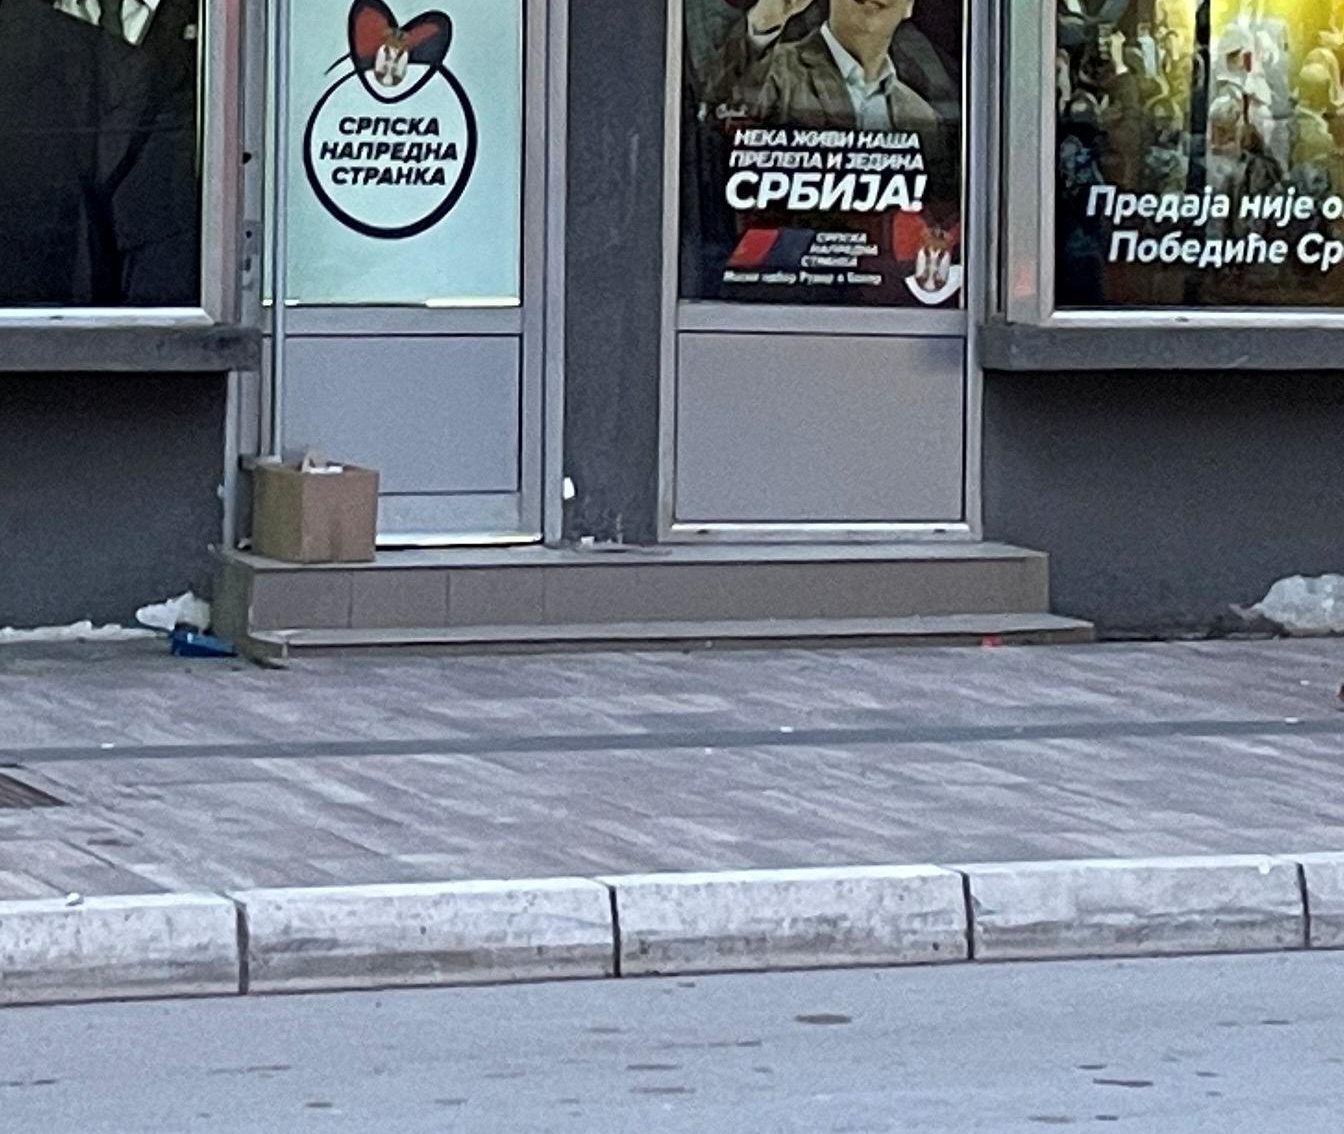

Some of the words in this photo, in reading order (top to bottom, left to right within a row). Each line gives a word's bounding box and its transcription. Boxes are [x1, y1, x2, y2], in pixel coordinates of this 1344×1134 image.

[338, 117, 441, 136] СРПСКА
[733, 129, 788, 146] НЕКА
[791, 130, 855, 148] ЖИВИ
[857, 131, 921, 149] НАША
[319, 141, 459, 162] НАПРЕДНА
[728, 150, 823, 168] ПРЕЛЕПА
[826, 152, 843, 169] И
[845, 152, 925, 171] ЈЕДИНА
[331, 167, 446, 186] СТРАНКА
[724, 170, 929, 212] СРБИЈА!
[1086, 184, 1231, 224] Предаја
[1238, 187, 1313, 227] није
[1108, 230, 1289, 268] Победиће
